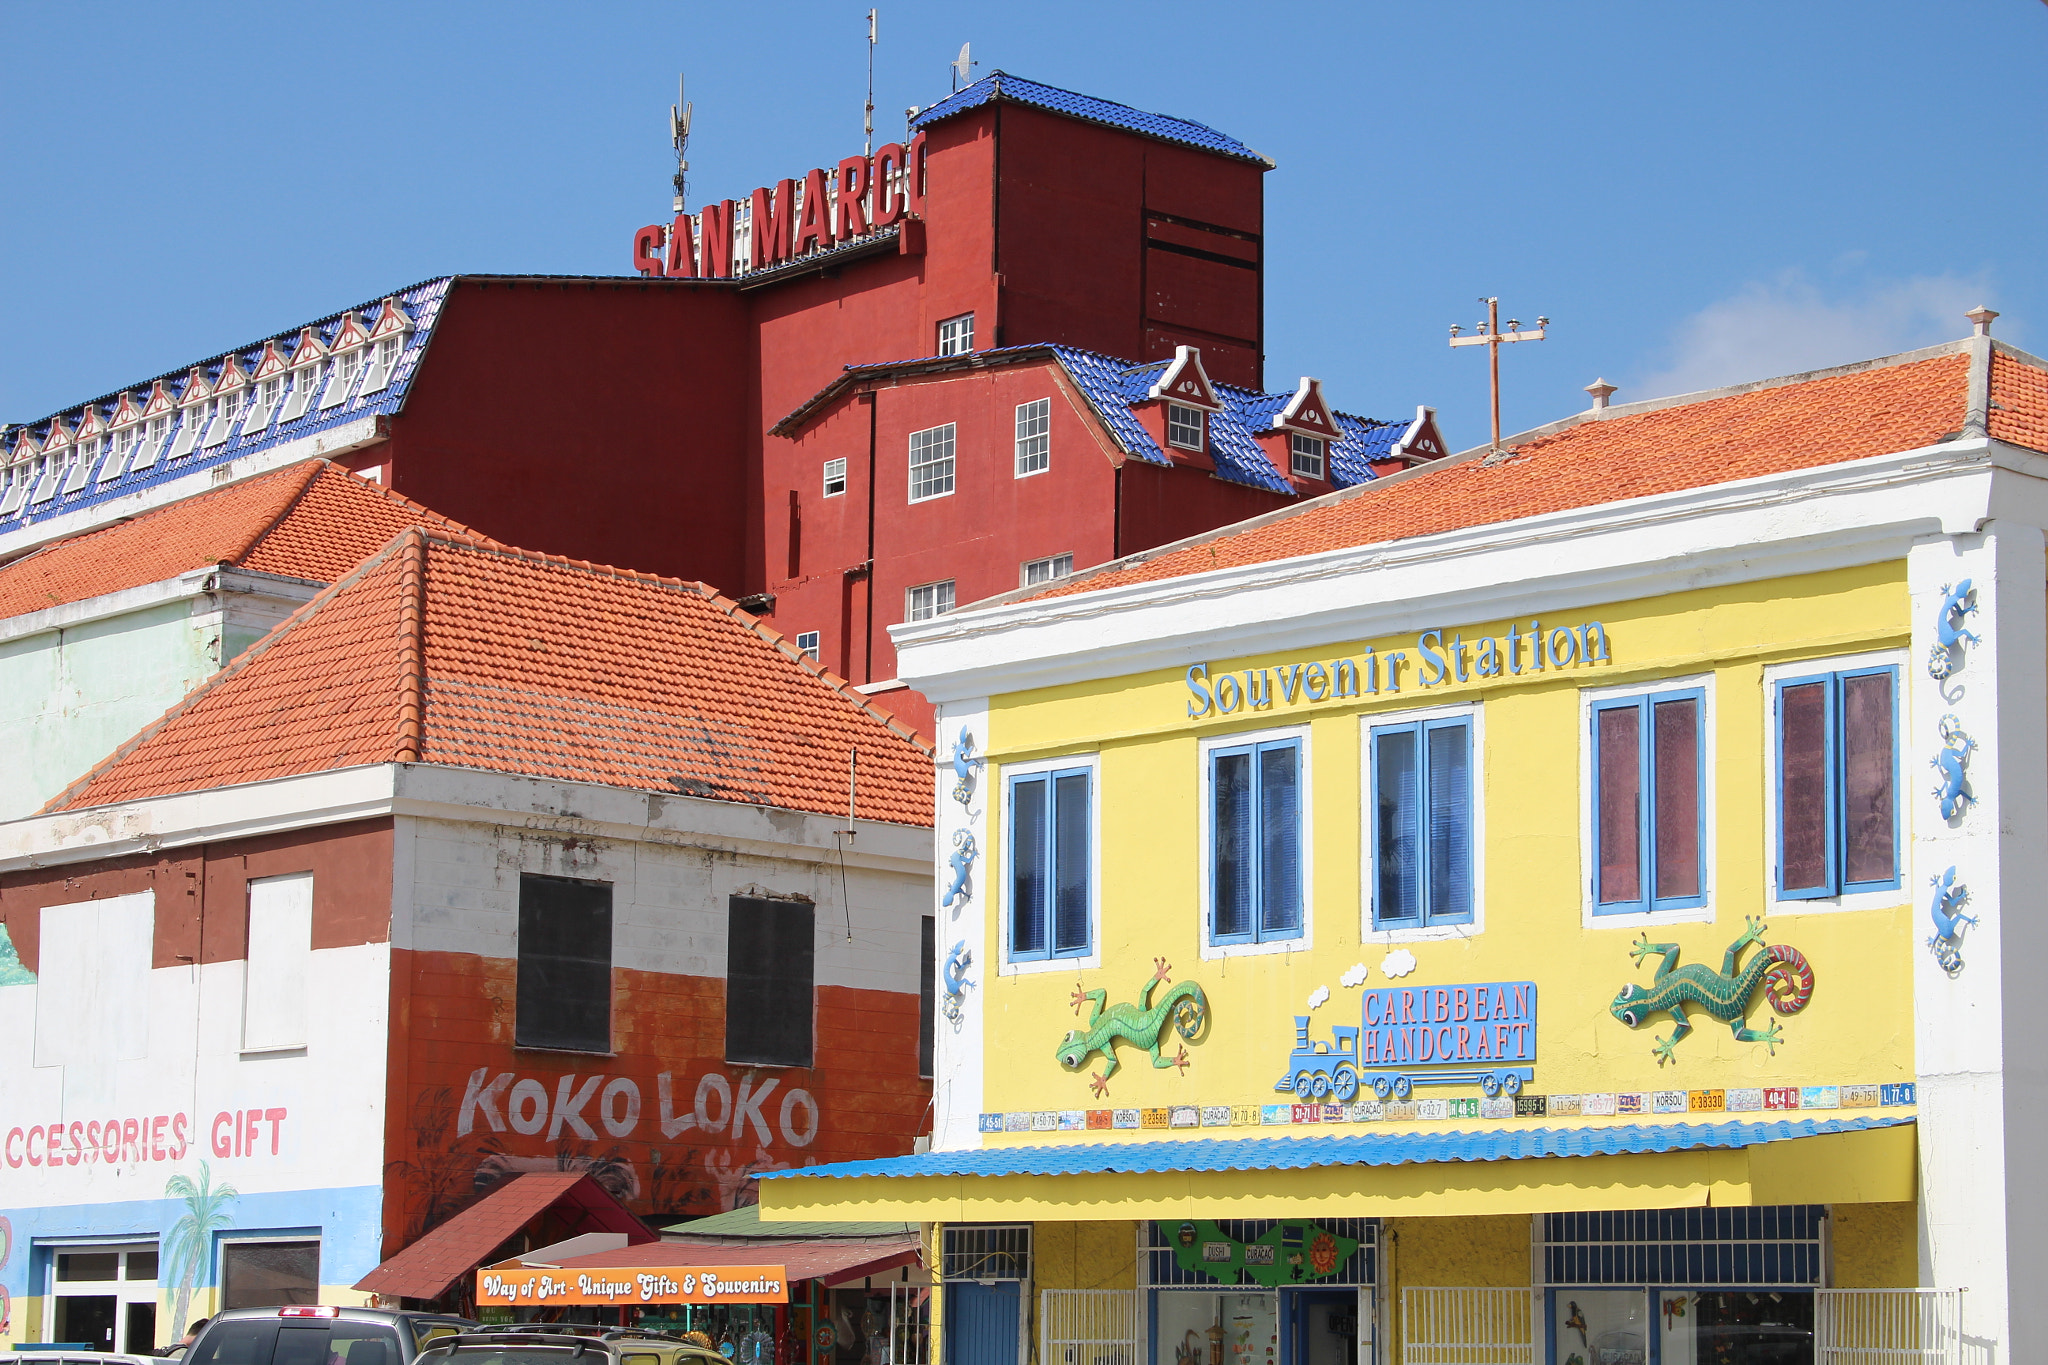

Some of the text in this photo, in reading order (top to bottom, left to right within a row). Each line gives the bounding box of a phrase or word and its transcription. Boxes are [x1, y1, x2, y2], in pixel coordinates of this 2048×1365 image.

[634, 199, 735, 278] SAN
[1187, 620, 1610, 718] Souvenir Station
[1365, 985, 1529, 1026] CARIBBEAN
[1365, 1023, 1529, 1063] HANDCRAFT
[457, 1067, 819, 1148] KOKO LOKO
[1656, 1095, 1682, 1107] KORSOU
[0, 1108, 287, 1169] CCESSORIES GIFT
[483, 1275, 518, 1302] Way
[521, 1277, 536, 1298] of
[538, 1275, 566, 1299] Art
[578, 1274, 632, 1300] Unique
[636, 1273, 679, 1301] Gifts
[682, 1273, 696, 1295] &
[700, 1272, 780, 1298] Souvenirs
[1328, 1314, 1354, 1332] OPEN
